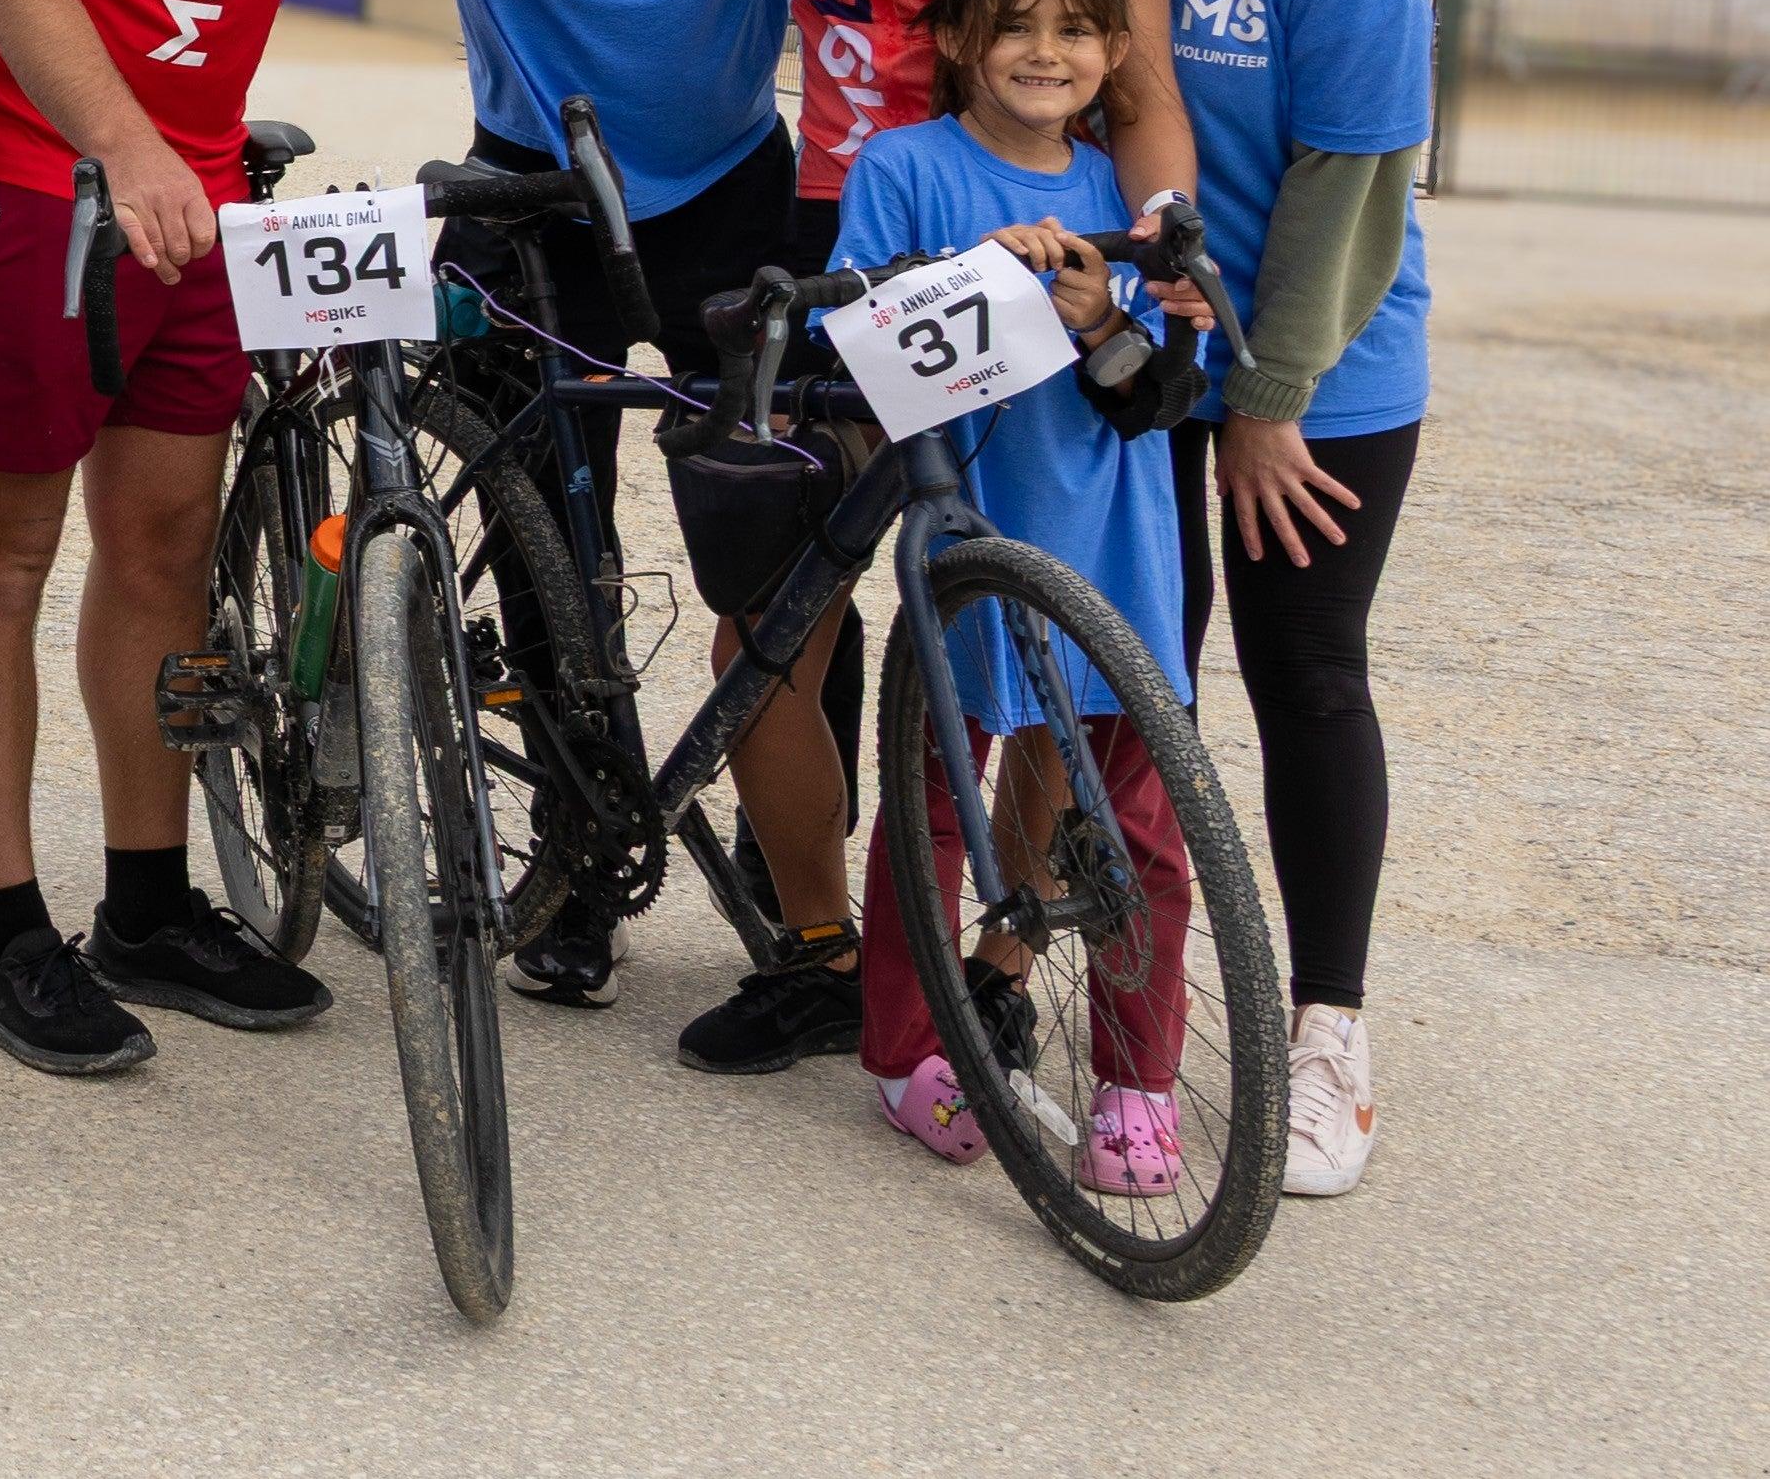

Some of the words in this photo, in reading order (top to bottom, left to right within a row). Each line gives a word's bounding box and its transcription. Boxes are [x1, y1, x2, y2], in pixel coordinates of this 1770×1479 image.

[1174, 42, 1268, 68] VOLUNTEER
[263, 215, 289, 233] 36TH
[292, 212, 342, 230] ANNUAL
[346, 208, 382, 225] GIMLI
[254, 232, 406, 297] 134
[305, 305, 367, 323] MSBIKE
[871, 305, 898, 329] 36TH
[899, 284, 951, 316] ANNUAL
[949, 268, 984, 292] GIMLI
[897, 291, 991, 379] 37
[944, 360, 1009, 395] MSBIKE
